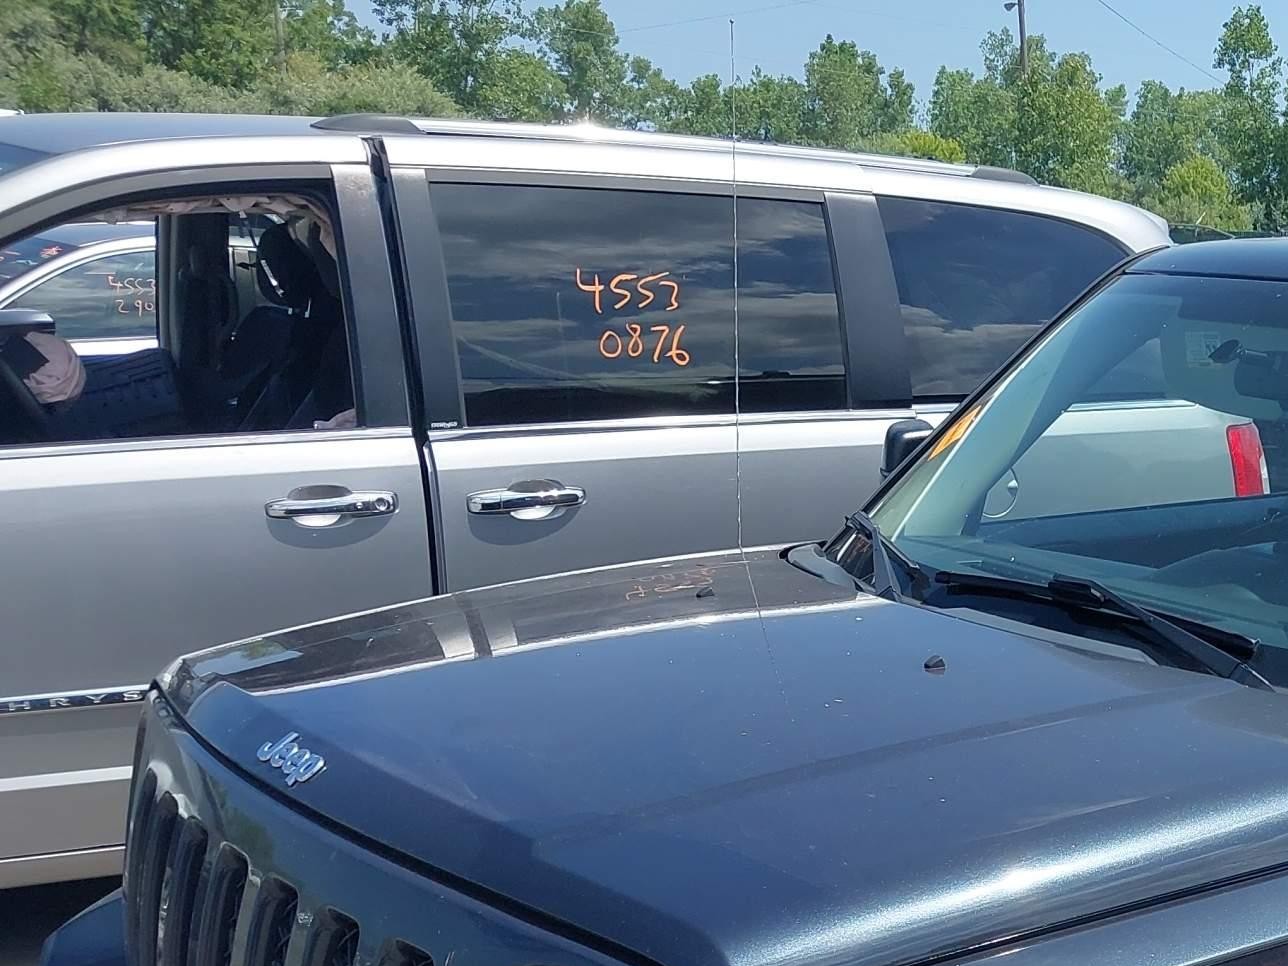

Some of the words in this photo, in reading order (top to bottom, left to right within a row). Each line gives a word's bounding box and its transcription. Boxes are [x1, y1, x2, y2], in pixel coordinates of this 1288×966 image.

[115, 299, 156, 317] 290
[576, 268, 678, 314] 4553
[600, 319, 690, 366] 0876
[257, 732, 326, 786] Jeep
